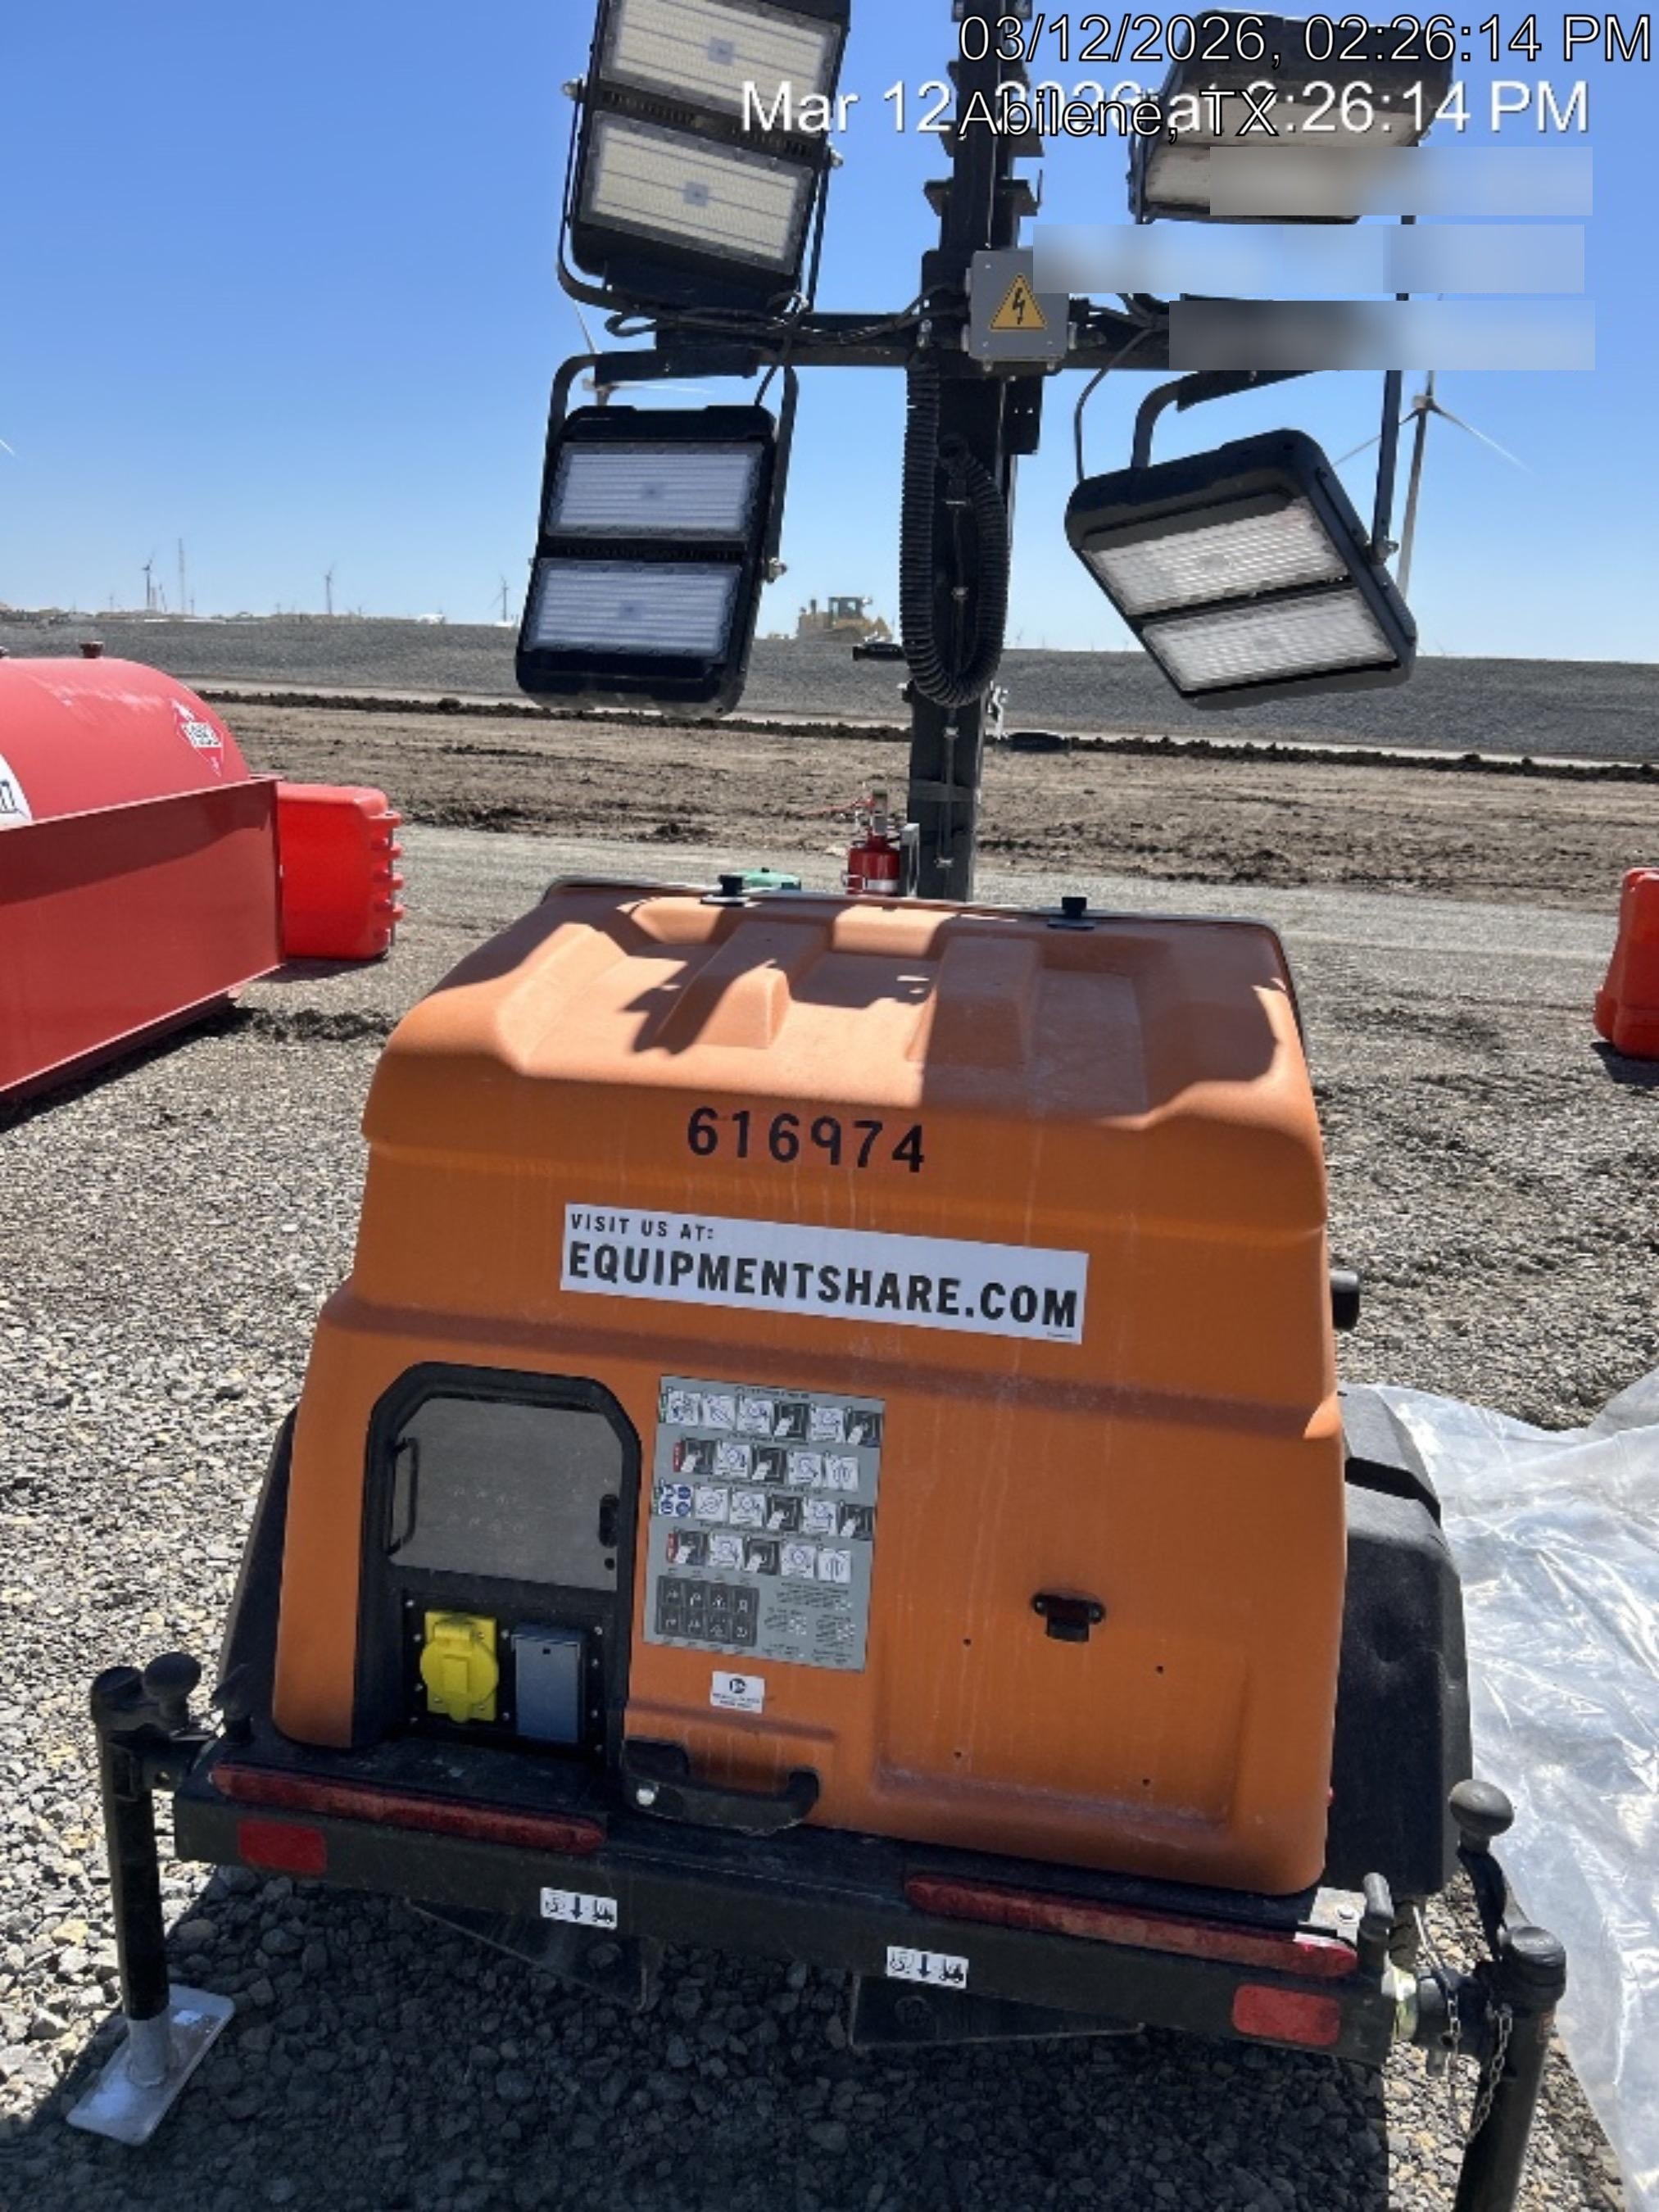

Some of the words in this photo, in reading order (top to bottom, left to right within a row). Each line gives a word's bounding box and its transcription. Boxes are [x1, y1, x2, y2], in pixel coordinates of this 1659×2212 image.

[687, 1106, 924, 1172] 616974
[571, 1213, 630, 1235] VISIT
[641, 1219, 668, 1237] US
[679, 1223, 714, 1241] AT:
[569, 1240, 1077, 1328] EQUIPMENTSHARE.COM
